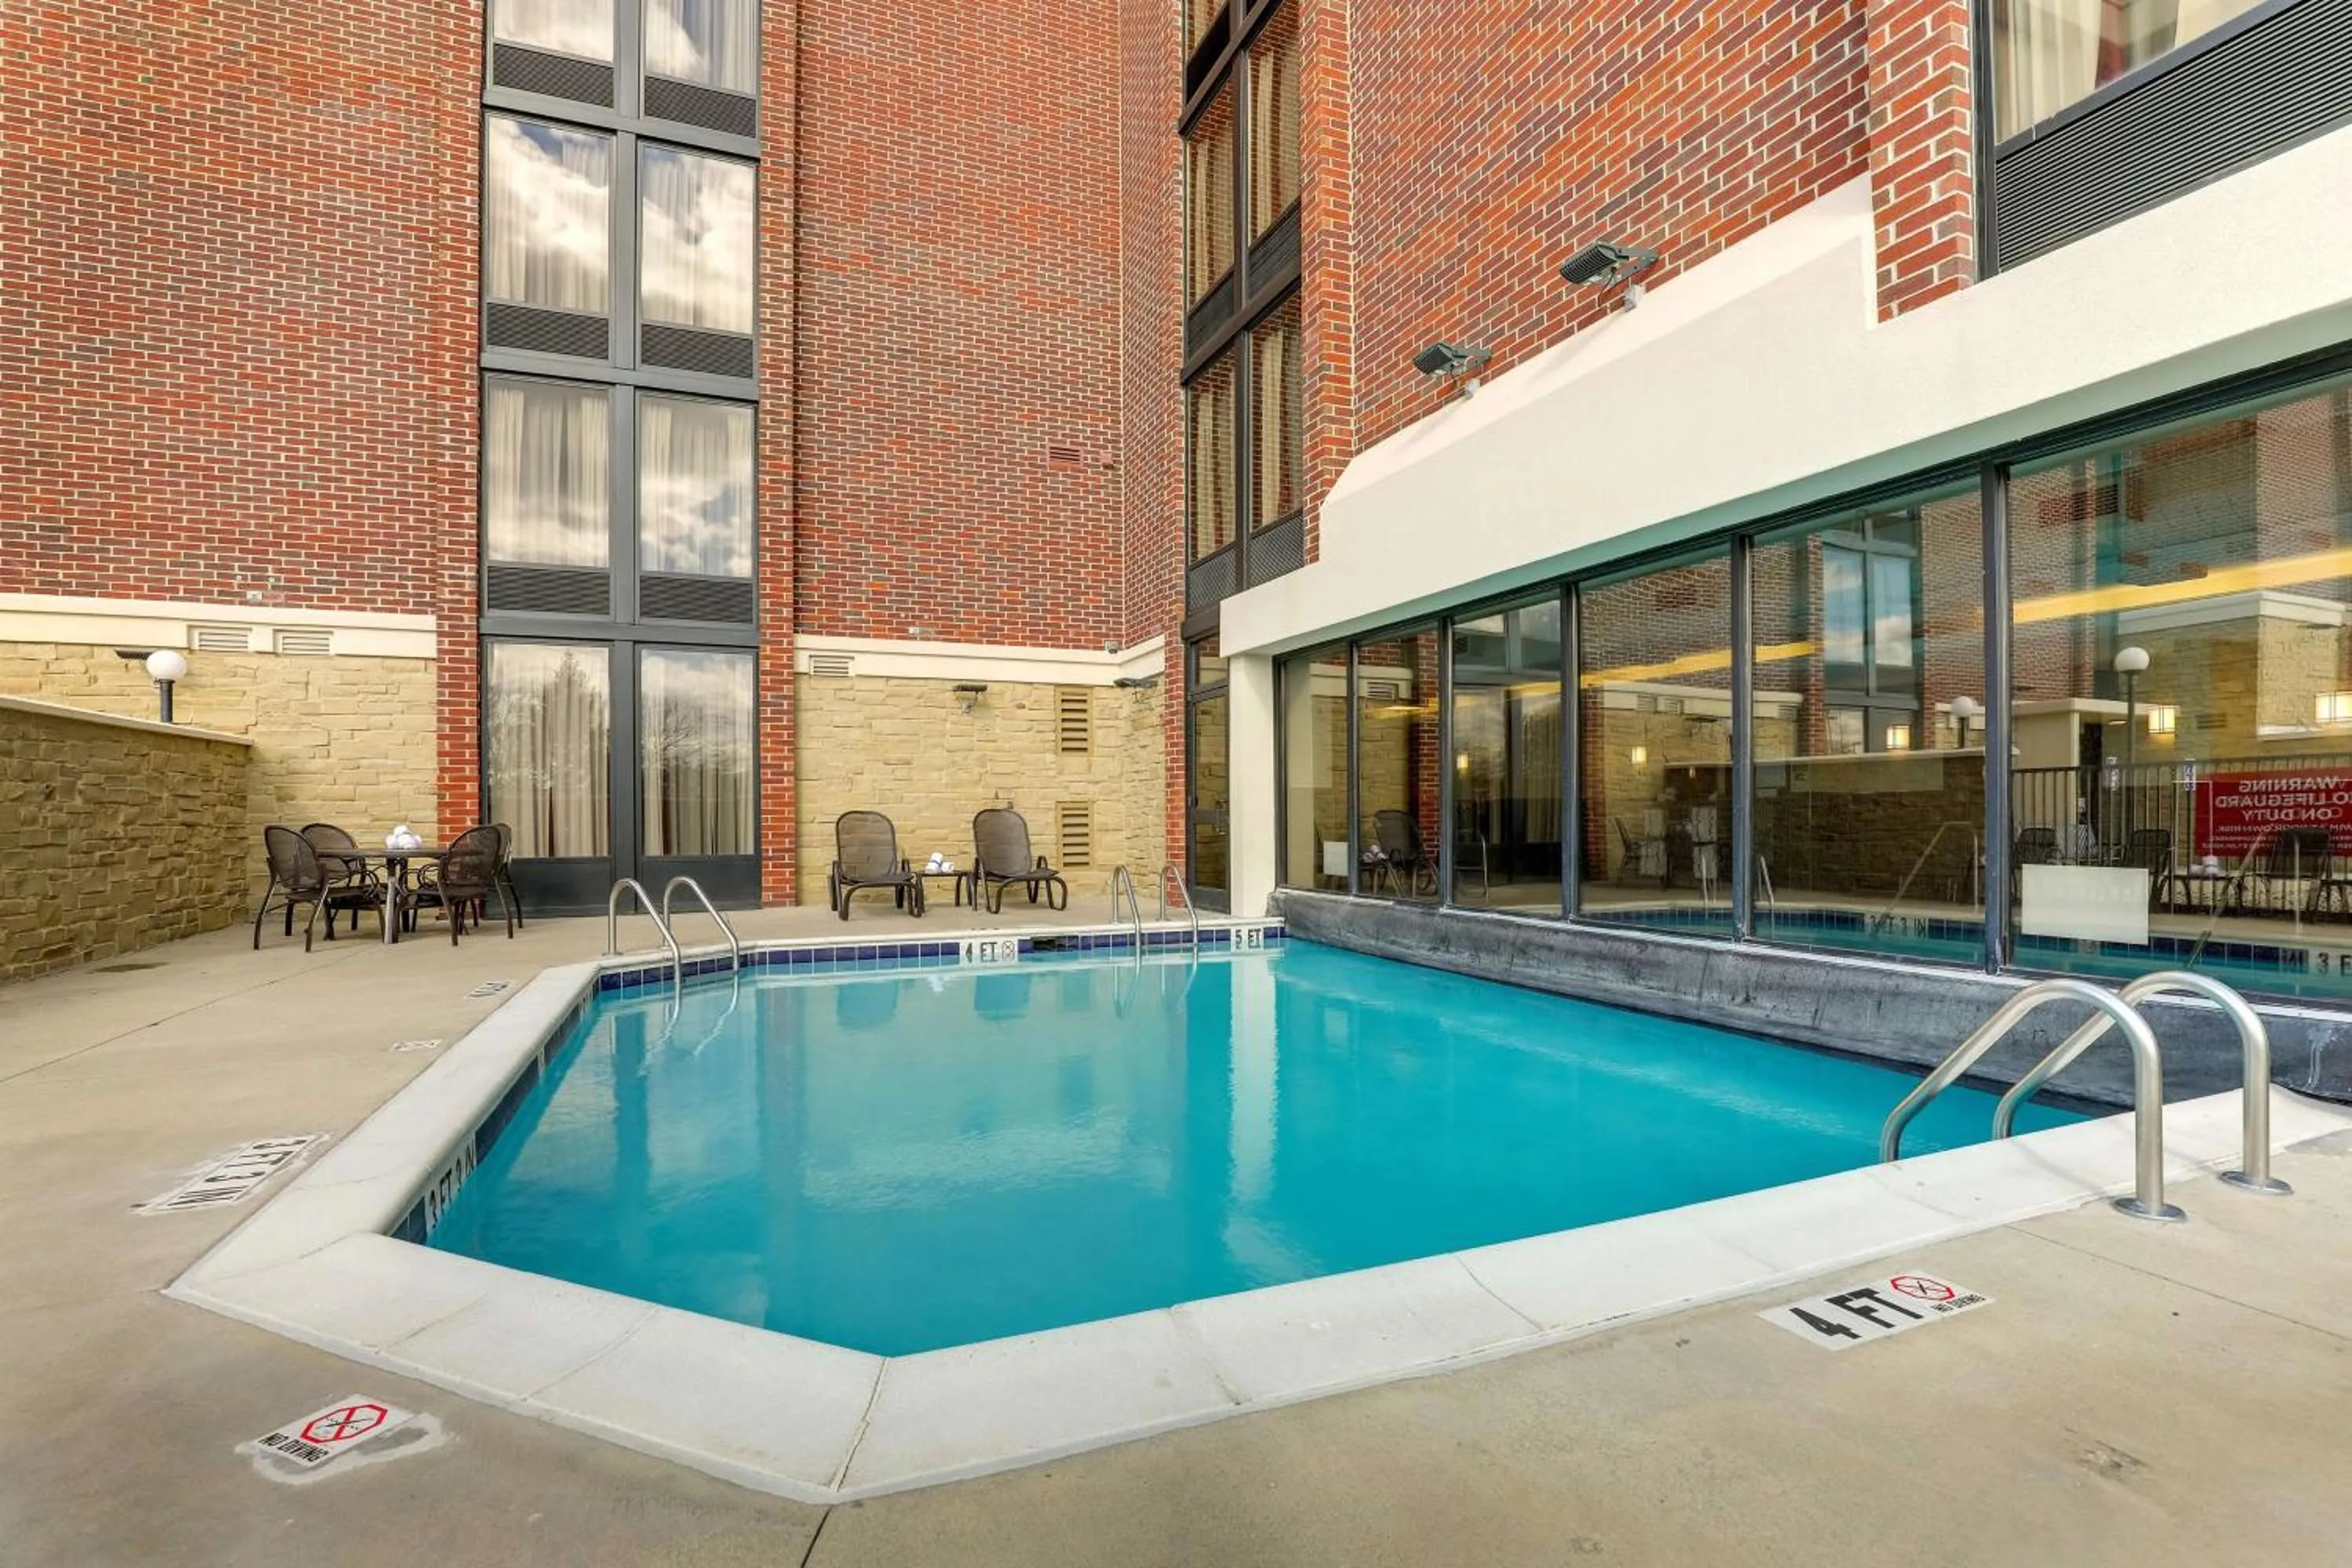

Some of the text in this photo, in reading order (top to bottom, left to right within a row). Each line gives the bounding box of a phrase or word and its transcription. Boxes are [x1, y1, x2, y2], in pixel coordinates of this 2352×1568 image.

[1788, 1287, 1924, 1339] 4 FT
[257, 1432, 329, 1462] NO DIVING
